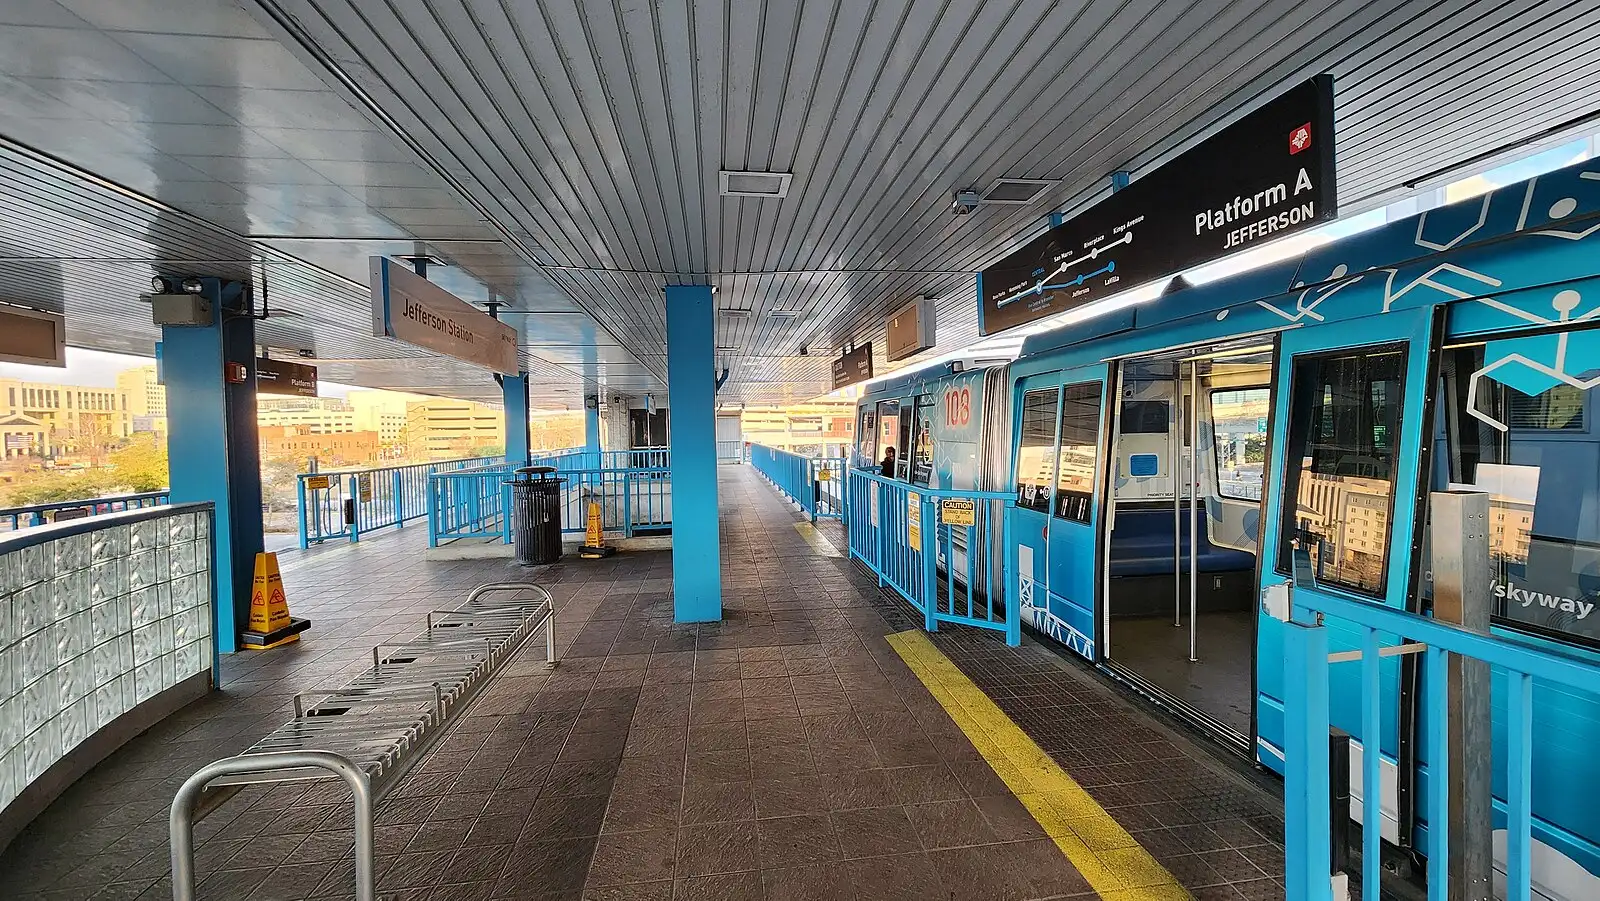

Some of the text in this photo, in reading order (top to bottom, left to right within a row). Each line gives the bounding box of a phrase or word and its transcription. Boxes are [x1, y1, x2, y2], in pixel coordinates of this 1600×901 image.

[1195, 167, 1313, 235] Platform A
[1113, 215, 1145, 235] Kings Avenue
[1223, 201, 1314, 249] JEFFERSON
[1083, 234, 1105, 249] Riverplace
[1071, 287, 1090, 298] Jefferson
[402, 298, 474, 344] Jefferson Station
[291, 378, 311, 388] Platform
[944, 387, 970, 427] 108
[944, 501, 972, 510] CAUTION
